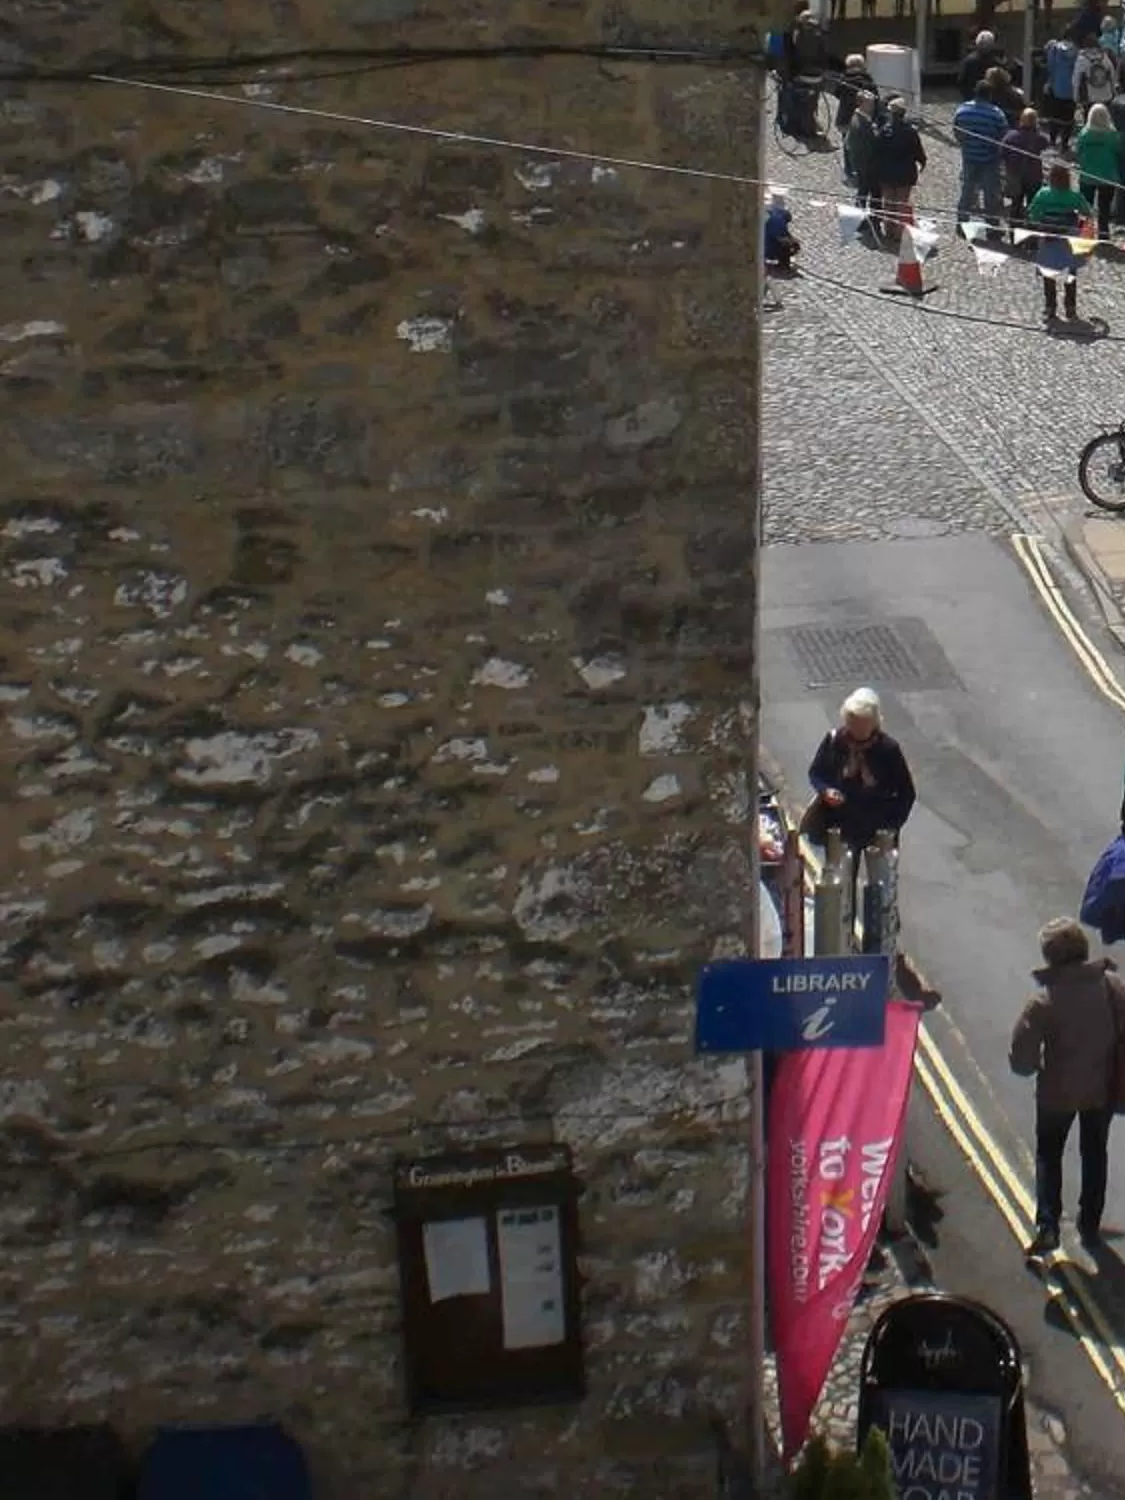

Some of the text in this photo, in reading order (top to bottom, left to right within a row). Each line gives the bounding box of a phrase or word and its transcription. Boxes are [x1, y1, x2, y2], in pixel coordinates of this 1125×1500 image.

[772, 972, 872, 993] LIBRARY
[820, 1136, 851, 1180] to
[889, 1409, 984, 1449] HAND
[891, 1448, 982, 1487] MADE
